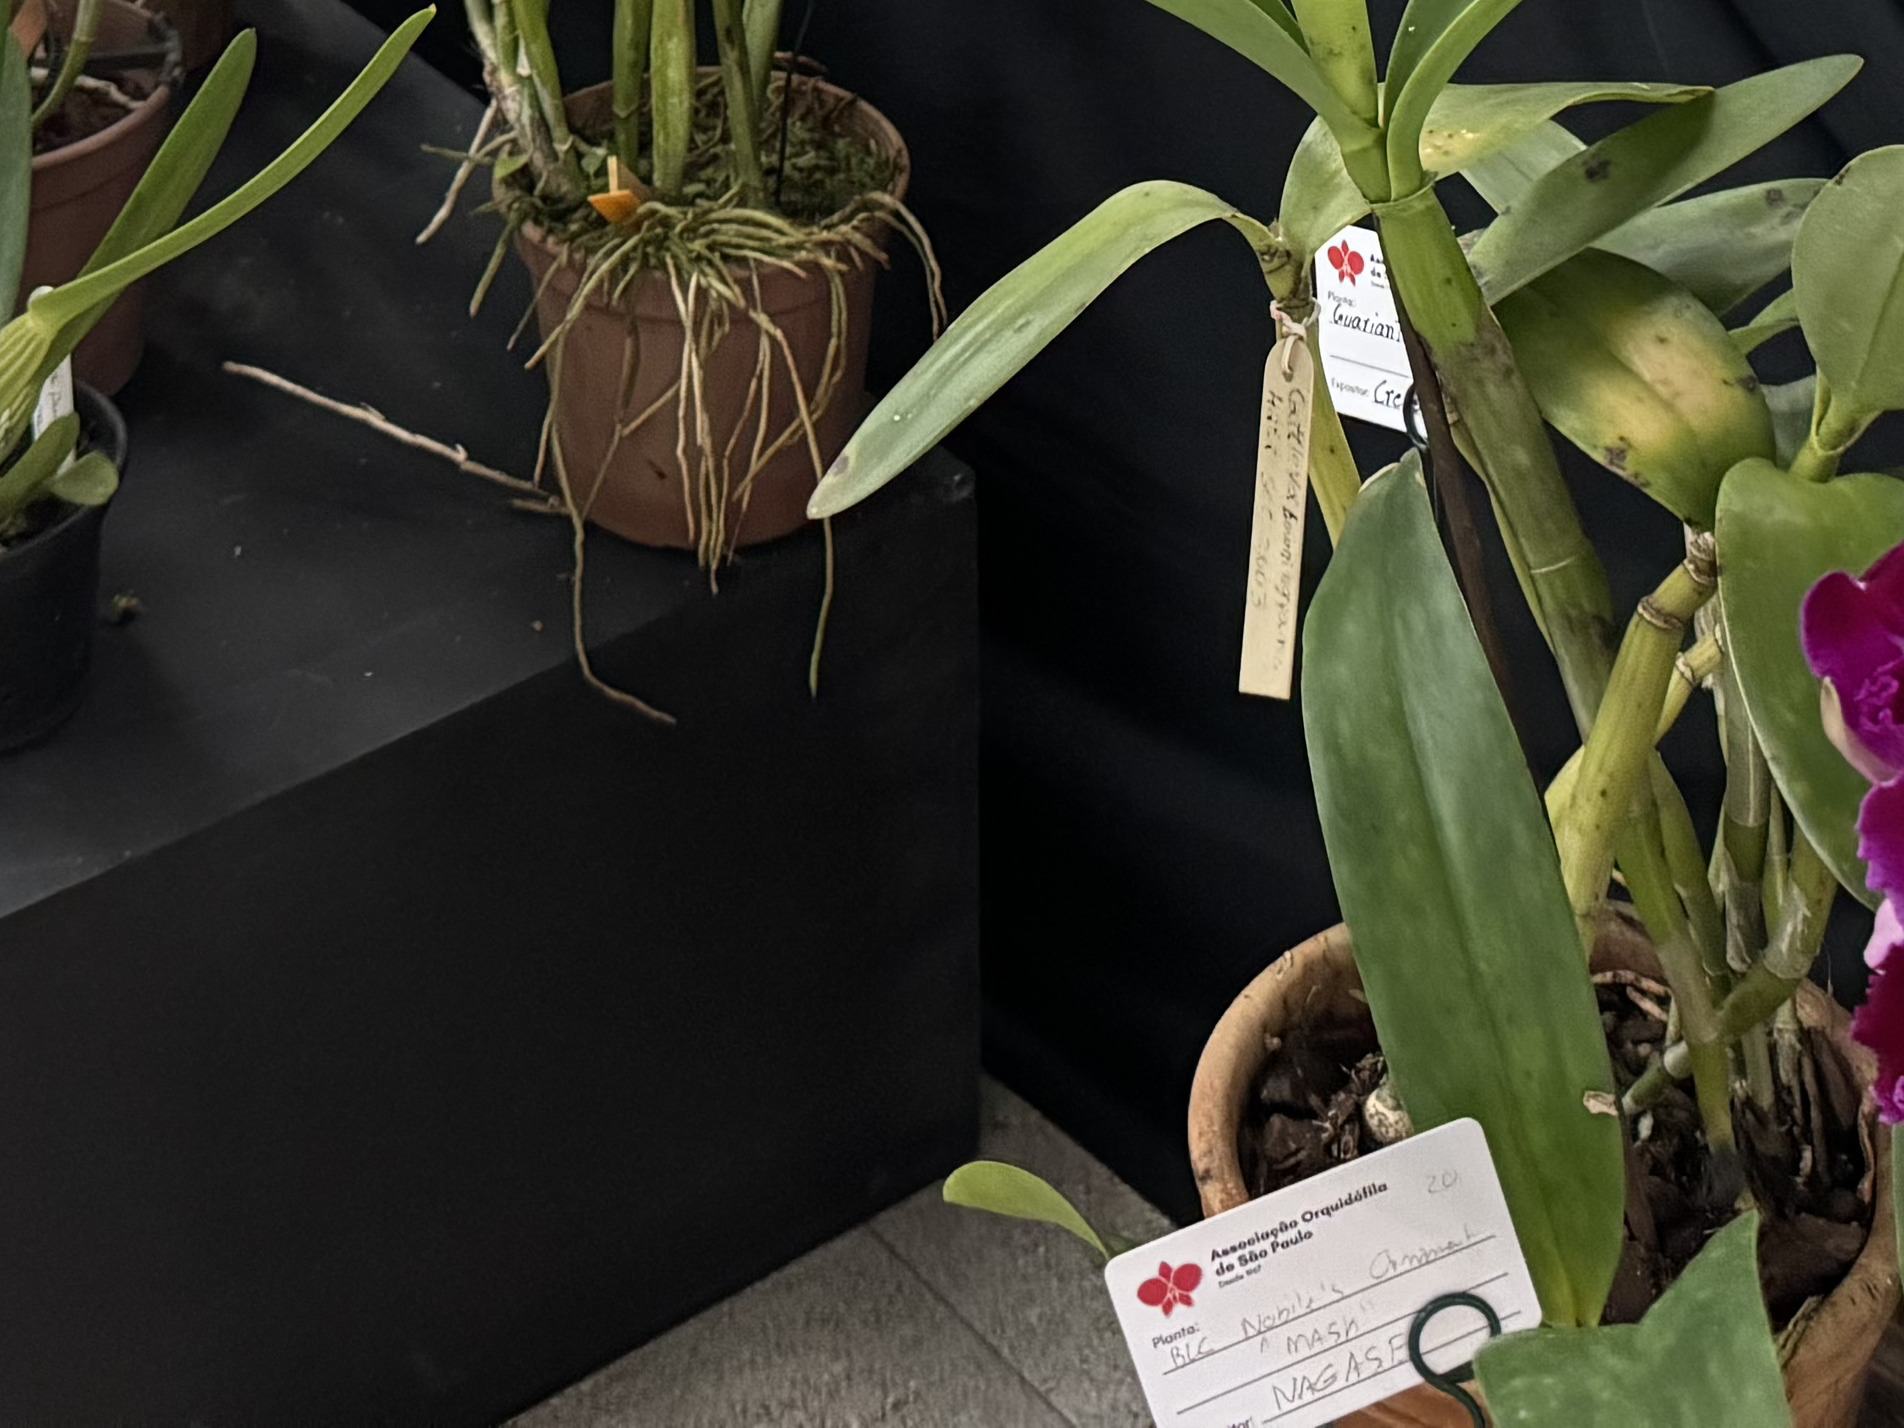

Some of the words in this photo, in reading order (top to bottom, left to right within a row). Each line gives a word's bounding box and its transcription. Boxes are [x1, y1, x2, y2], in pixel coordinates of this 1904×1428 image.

[1209, 1215, 1300, 1263] Associação
[1300, 1180, 1389, 1224] Orquidófila
[1215, 1259, 1236, 1278] de
[1236, 1244, 1269, 1270] São
[1269, 1227, 1314, 1259] Paulo
[1151, 1321, 1202, 1350] Planta:
